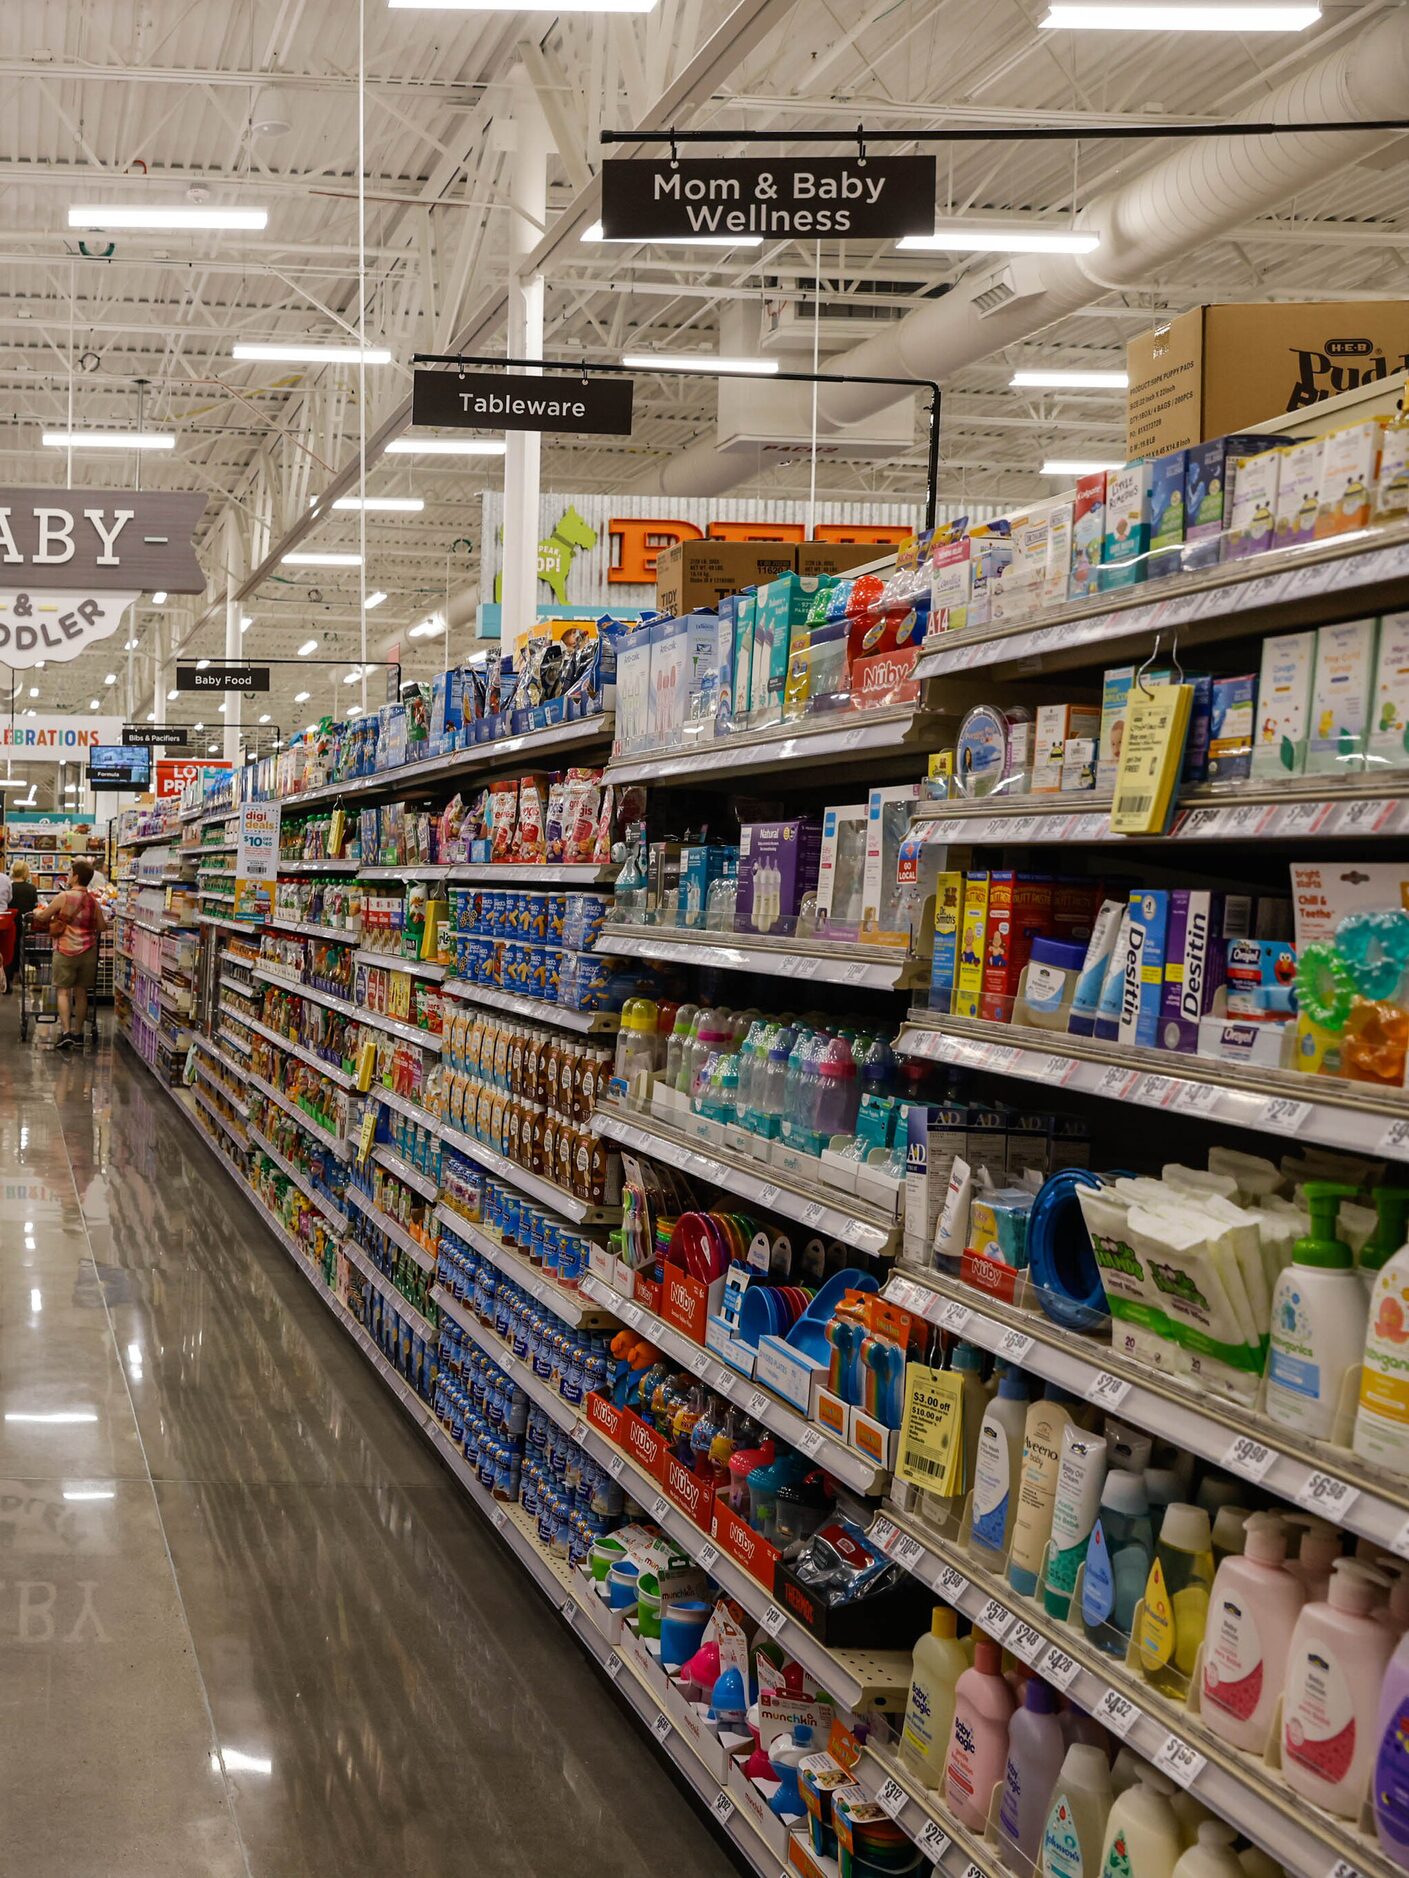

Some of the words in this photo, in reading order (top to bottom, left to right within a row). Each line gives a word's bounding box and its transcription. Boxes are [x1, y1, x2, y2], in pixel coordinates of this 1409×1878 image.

[653, 172, 742, 201] Mom
[754, 173, 778, 200] &
[792, 172, 886, 204] Baby
[686, 204, 851, 233] Wellness
[459, 392, 586, 419] Tableware
[13, 593, 33, 617] &
[195, 674, 225, 688] Baby
[227, 674, 253, 686] Food
[129, 734, 144, 742] Bibs
[144, 734, 150, 742] &
[151, 734, 180, 743] Pacifiers
[245, 820, 274, 831] deals
[246, 811, 267, 824] digi
[243, 835, 263, 847] $10
[759, 828, 780, 839] Natural
[898, 870, 917, 880] LOCAL
[904, 862, 912, 871] GO
[1295, 870, 1321, 881] bright
[1296, 878, 1322, 888] starts
[1298, 895, 1319, 906] Chill
[1183, 912, 1207, 1018] Desitin
[1120, 926, 1145, 1026] Desitin
[1097, 1377, 1121, 1393] $218
[913, 1391, 939, 1408] $3.00
[939, 1402, 951, 1412] off
[911, 1406, 935, 1420] $10.00
[1234, 1439, 1269, 1464] $998
[1309, 1474, 1348, 1500] $698
[942, 1568, 964, 1588] $398
[986, 1601, 1008, 1623] $578
[1015, 1624, 1041, 1647] $248
[1048, 1650, 1073, 1673] $428
[1105, 1692, 1133, 1717] $432
[762, 1711, 818, 1727] munchkin
[955, 1717, 972, 1738] Baby
[955, 1731, 976, 1754] Magic
[884, 1781, 904, 1801] $312
[925, 1823, 946, 1845] $272
